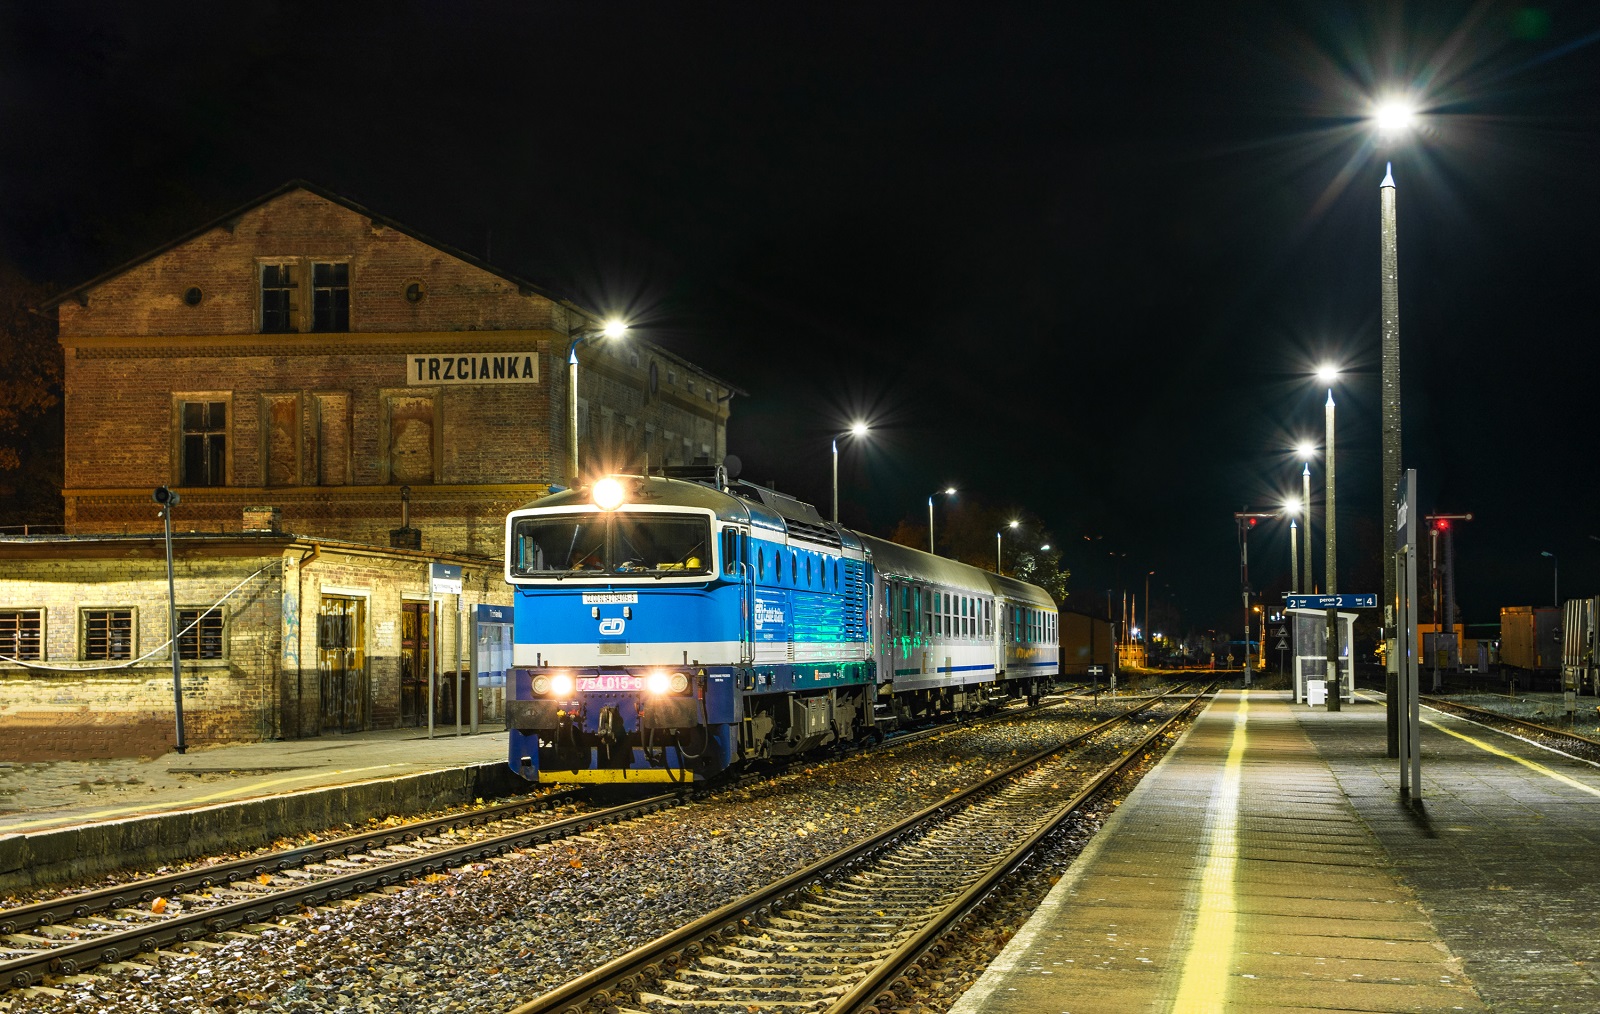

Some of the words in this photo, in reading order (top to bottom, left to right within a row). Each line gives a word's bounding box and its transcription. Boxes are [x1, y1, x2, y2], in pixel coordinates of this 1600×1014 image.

[414, 356, 534, 381] TRZCIANKA
[1290, 599, 1296, 608] 2
[1336, 596, 1343, 607] 2
[1366, 597, 1373, 606] 4
[581, 678, 604, 690] 754
